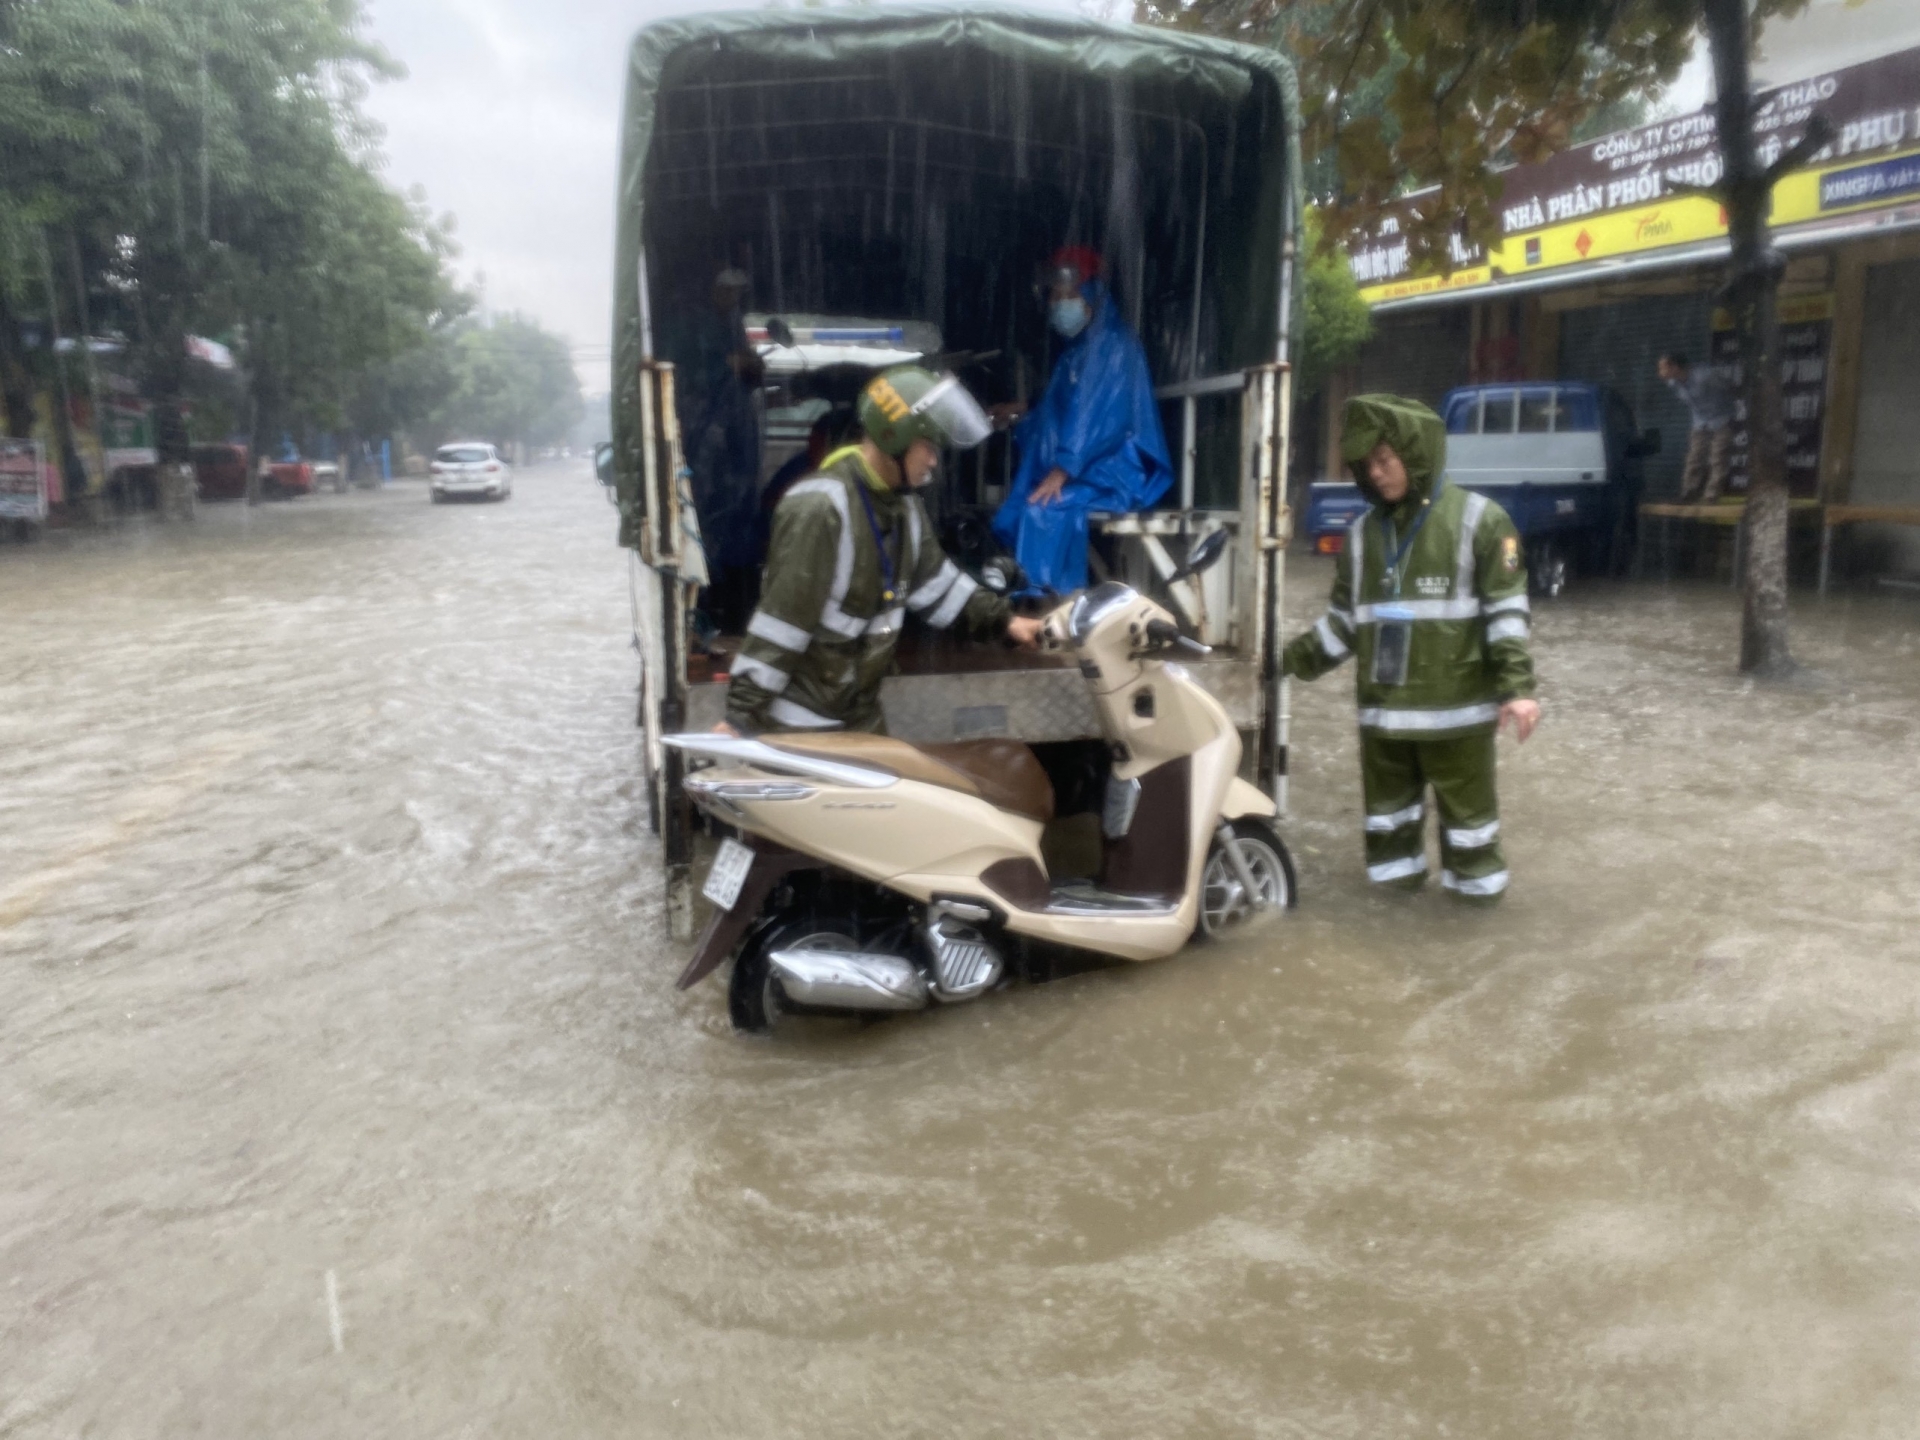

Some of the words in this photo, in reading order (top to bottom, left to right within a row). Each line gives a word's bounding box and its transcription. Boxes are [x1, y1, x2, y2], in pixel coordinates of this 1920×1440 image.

[1502, 196, 1545, 232] NHÀ
[1548, 183, 1604, 222] PHÂN
[1607, 162, 1662, 208] PHỐI
[1839, 109, 1907, 155] PHỤ
[1645, 126, 1664, 146] TY
